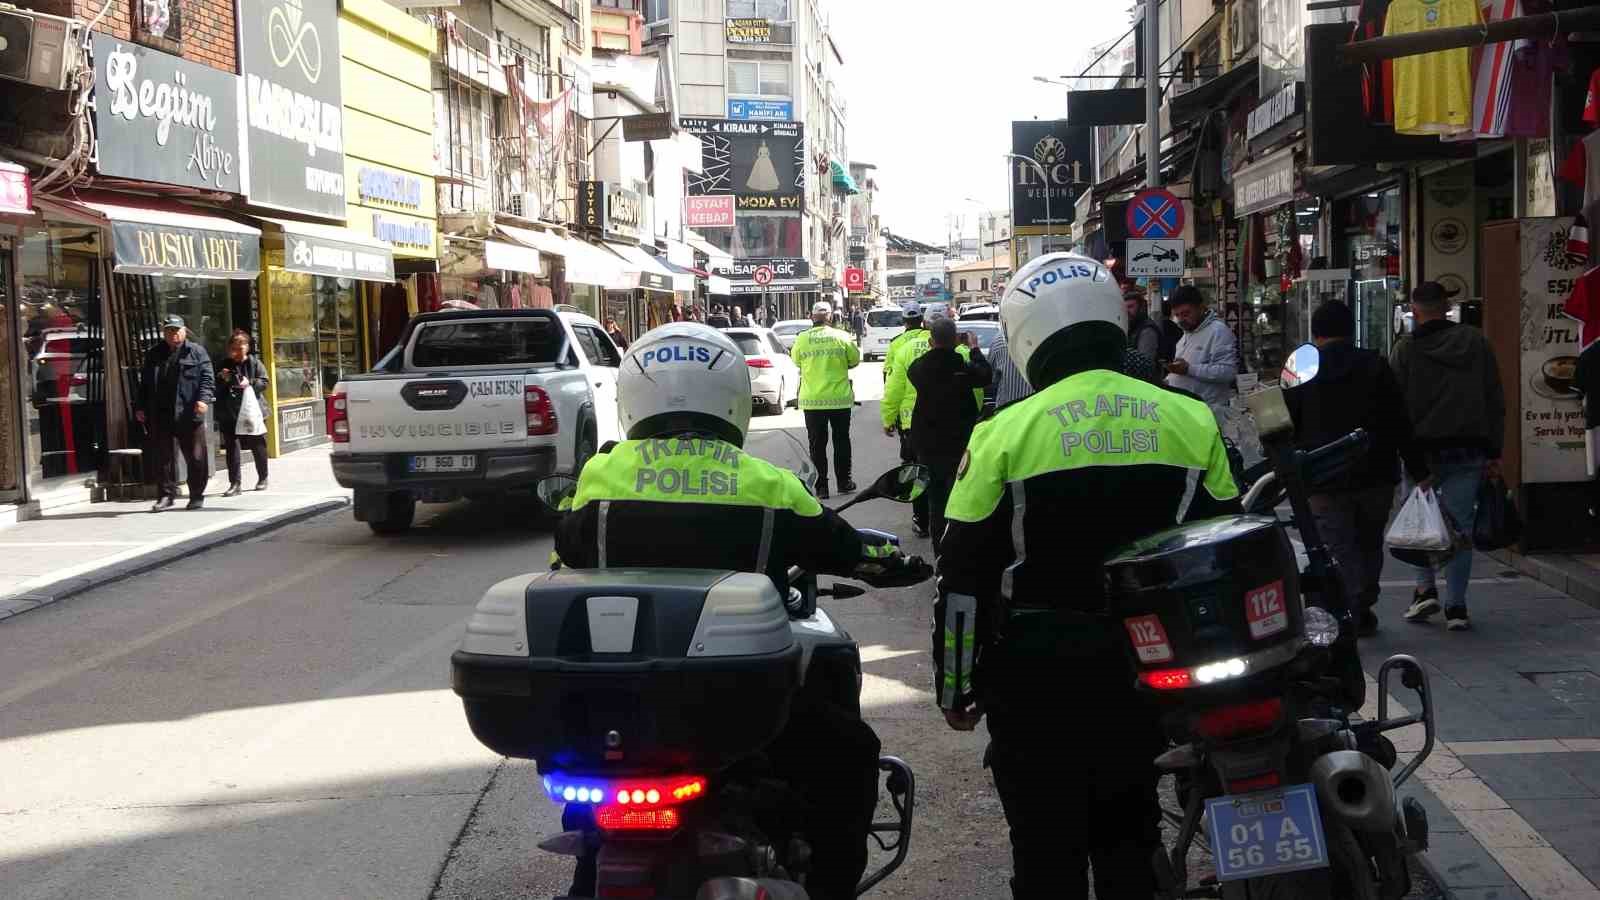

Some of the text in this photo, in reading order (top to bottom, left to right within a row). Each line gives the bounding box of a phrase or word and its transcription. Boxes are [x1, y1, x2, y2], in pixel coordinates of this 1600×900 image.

[107, 44, 216, 146] Begüm
[723, 122, 759, 134] KIRALIK
[186, 132, 233, 188] Abiye
[738, 196, 776, 209] MODA
[691, 212, 729, 225] KEBAP
[766, 261, 795, 275] İLGİÇ
[359, 421, 515, 439] INVINCIBLE
[462, 455, 474, 468] 01
[1251, 588, 1280, 617] 112
[1131, 622, 1161, 643] 112
[1231, 816, 1303, 845] 01 A
[1228, 838, 1313, 868] 56 55
